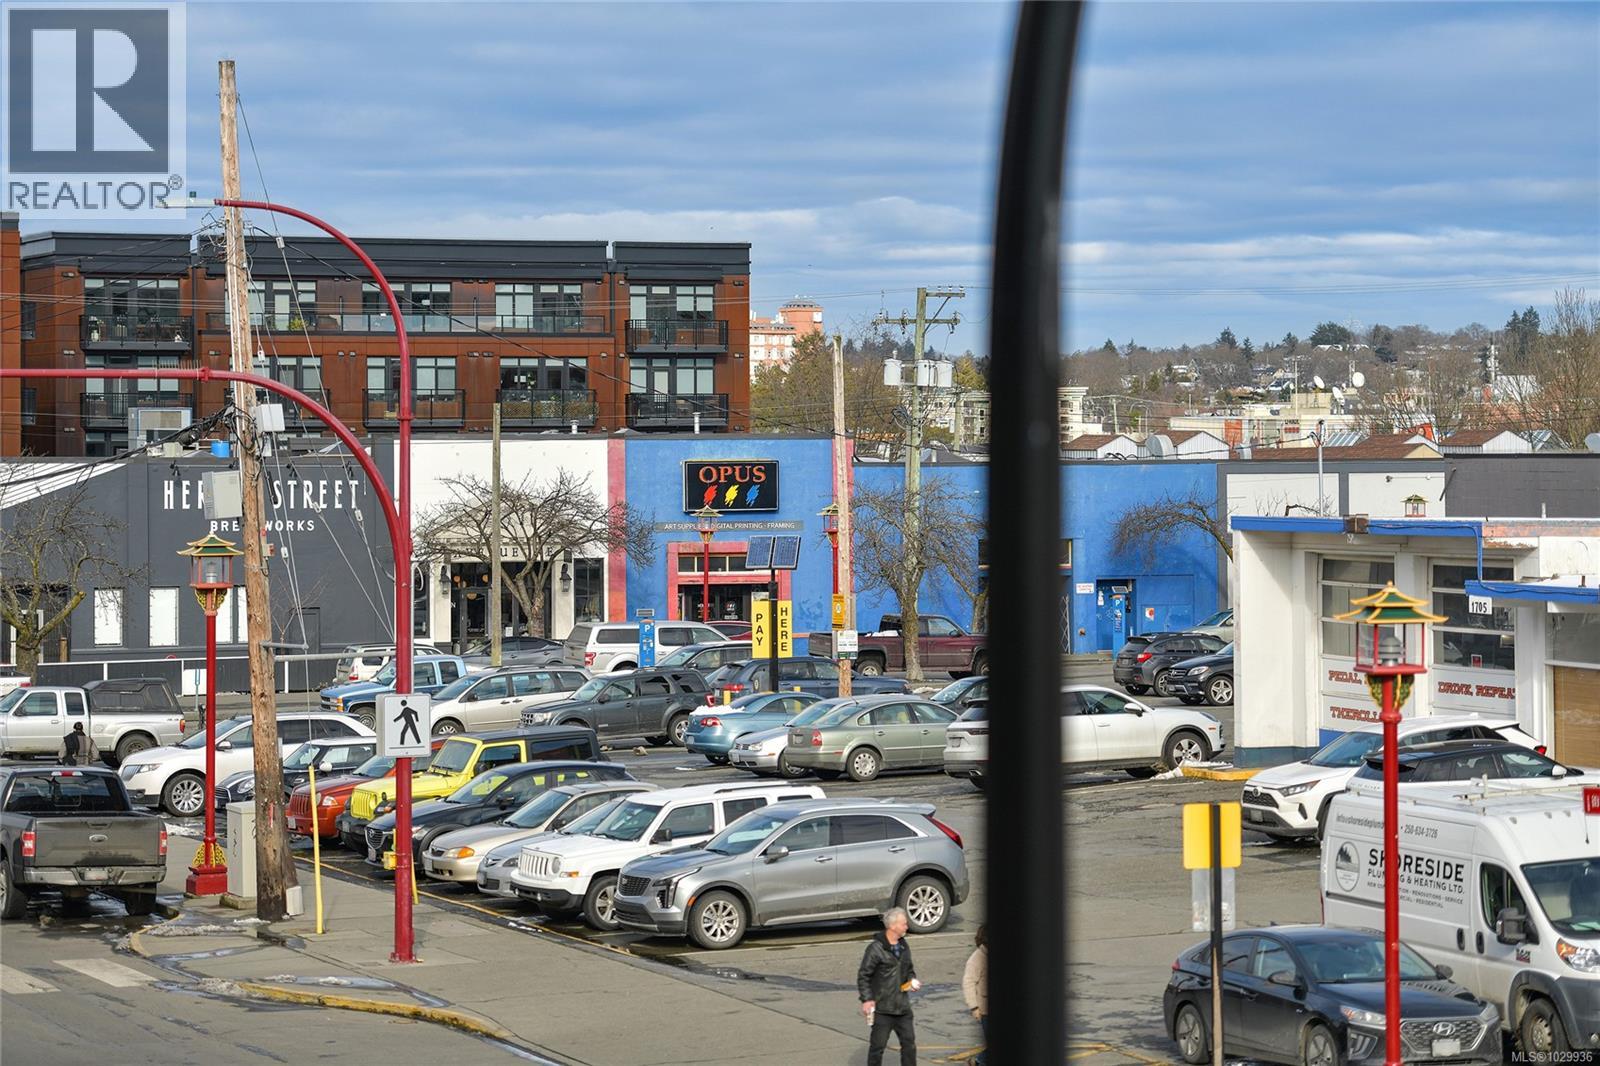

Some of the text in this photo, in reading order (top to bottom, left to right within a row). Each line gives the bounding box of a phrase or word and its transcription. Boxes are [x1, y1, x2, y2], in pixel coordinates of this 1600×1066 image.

[698, 465, 767, 483] OPUS
[273, 480, 359, 510] STREET
[1471, 601, 1488, 613] 1705
[644, 624, 651, 633] P
[756, 613, 764, 646] PAY
[780, 607, 788, 652] HERE
[1407, 874, 1413, 884] &
[1413, 876, 1447, 891] HEATING
